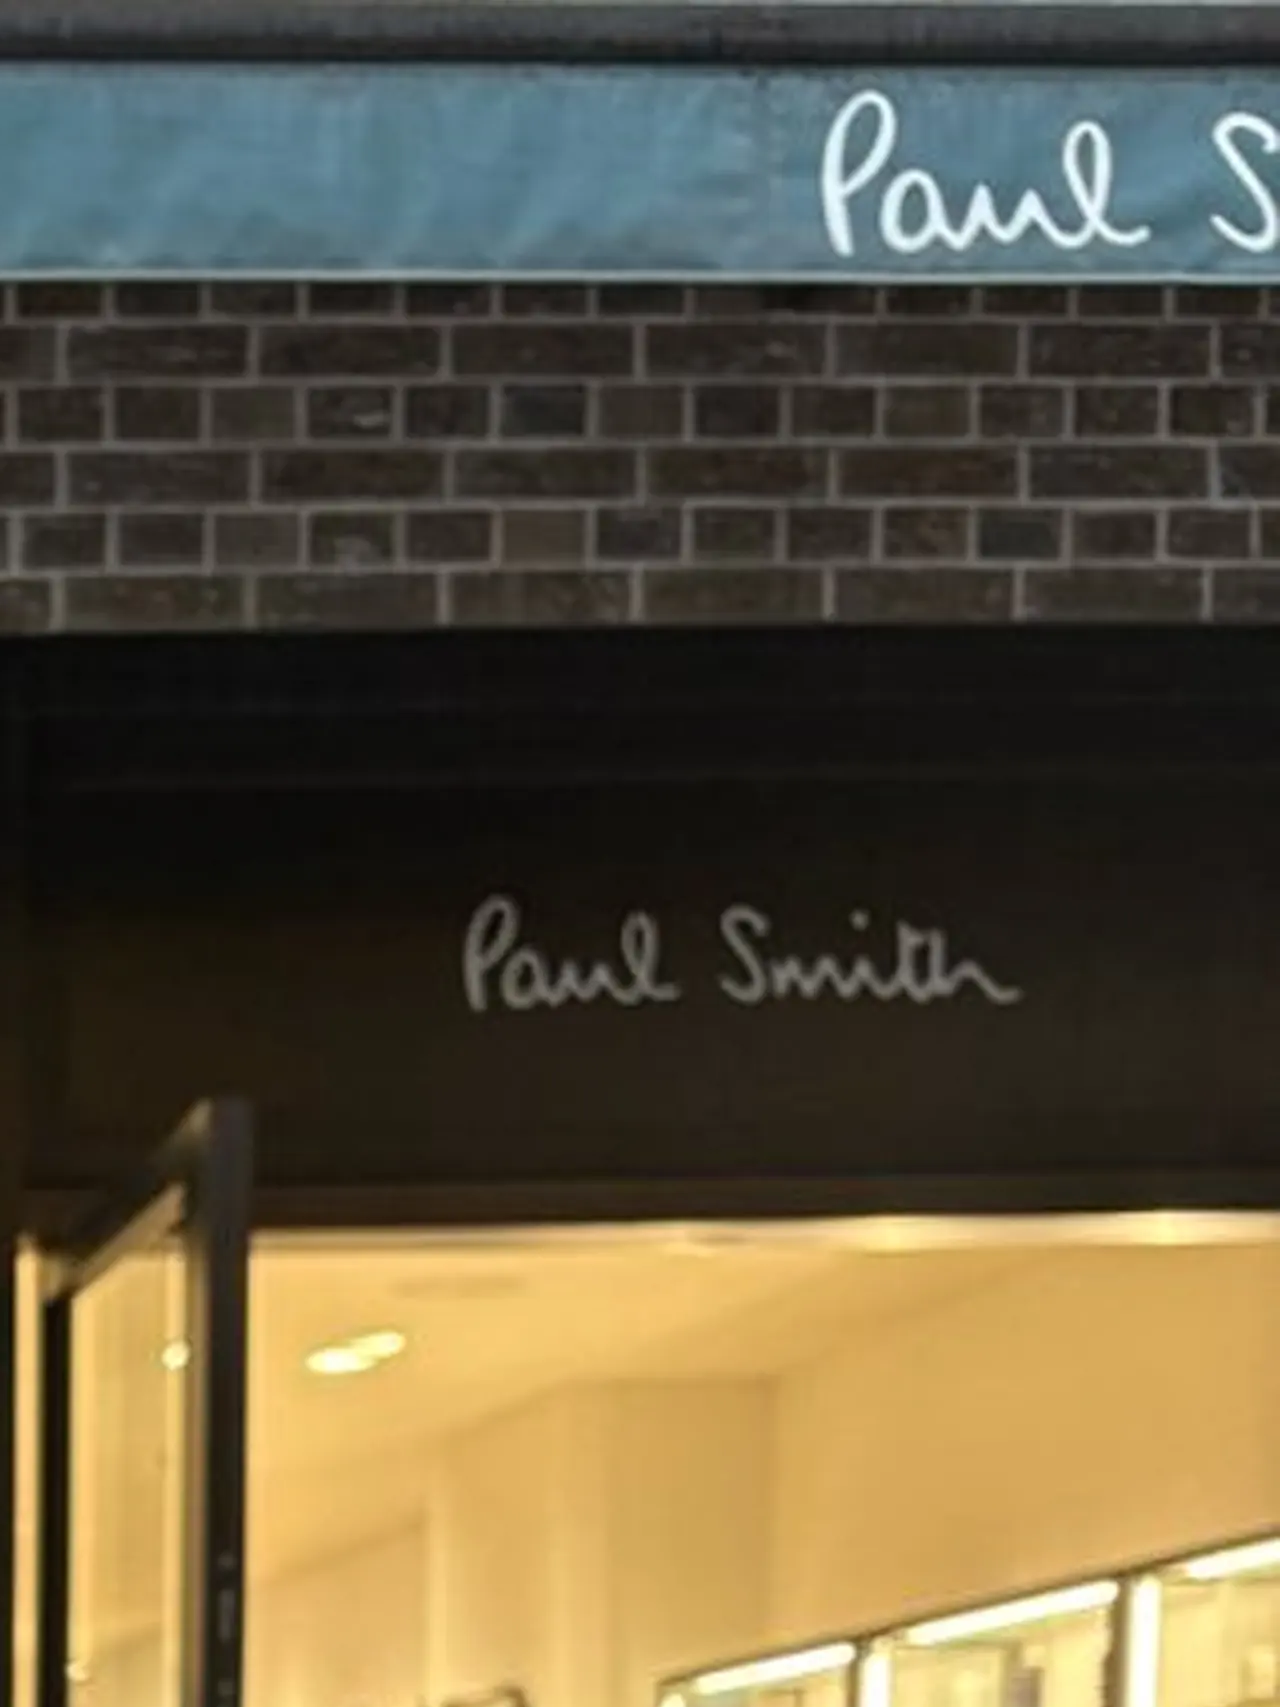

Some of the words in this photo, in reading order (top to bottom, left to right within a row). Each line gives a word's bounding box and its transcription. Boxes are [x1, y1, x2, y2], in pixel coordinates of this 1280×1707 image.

[820, 89, 1150, 257] Paul
[463, 896, 680, 1011] Paul
[720, 905, 1021, 1004] Smith
